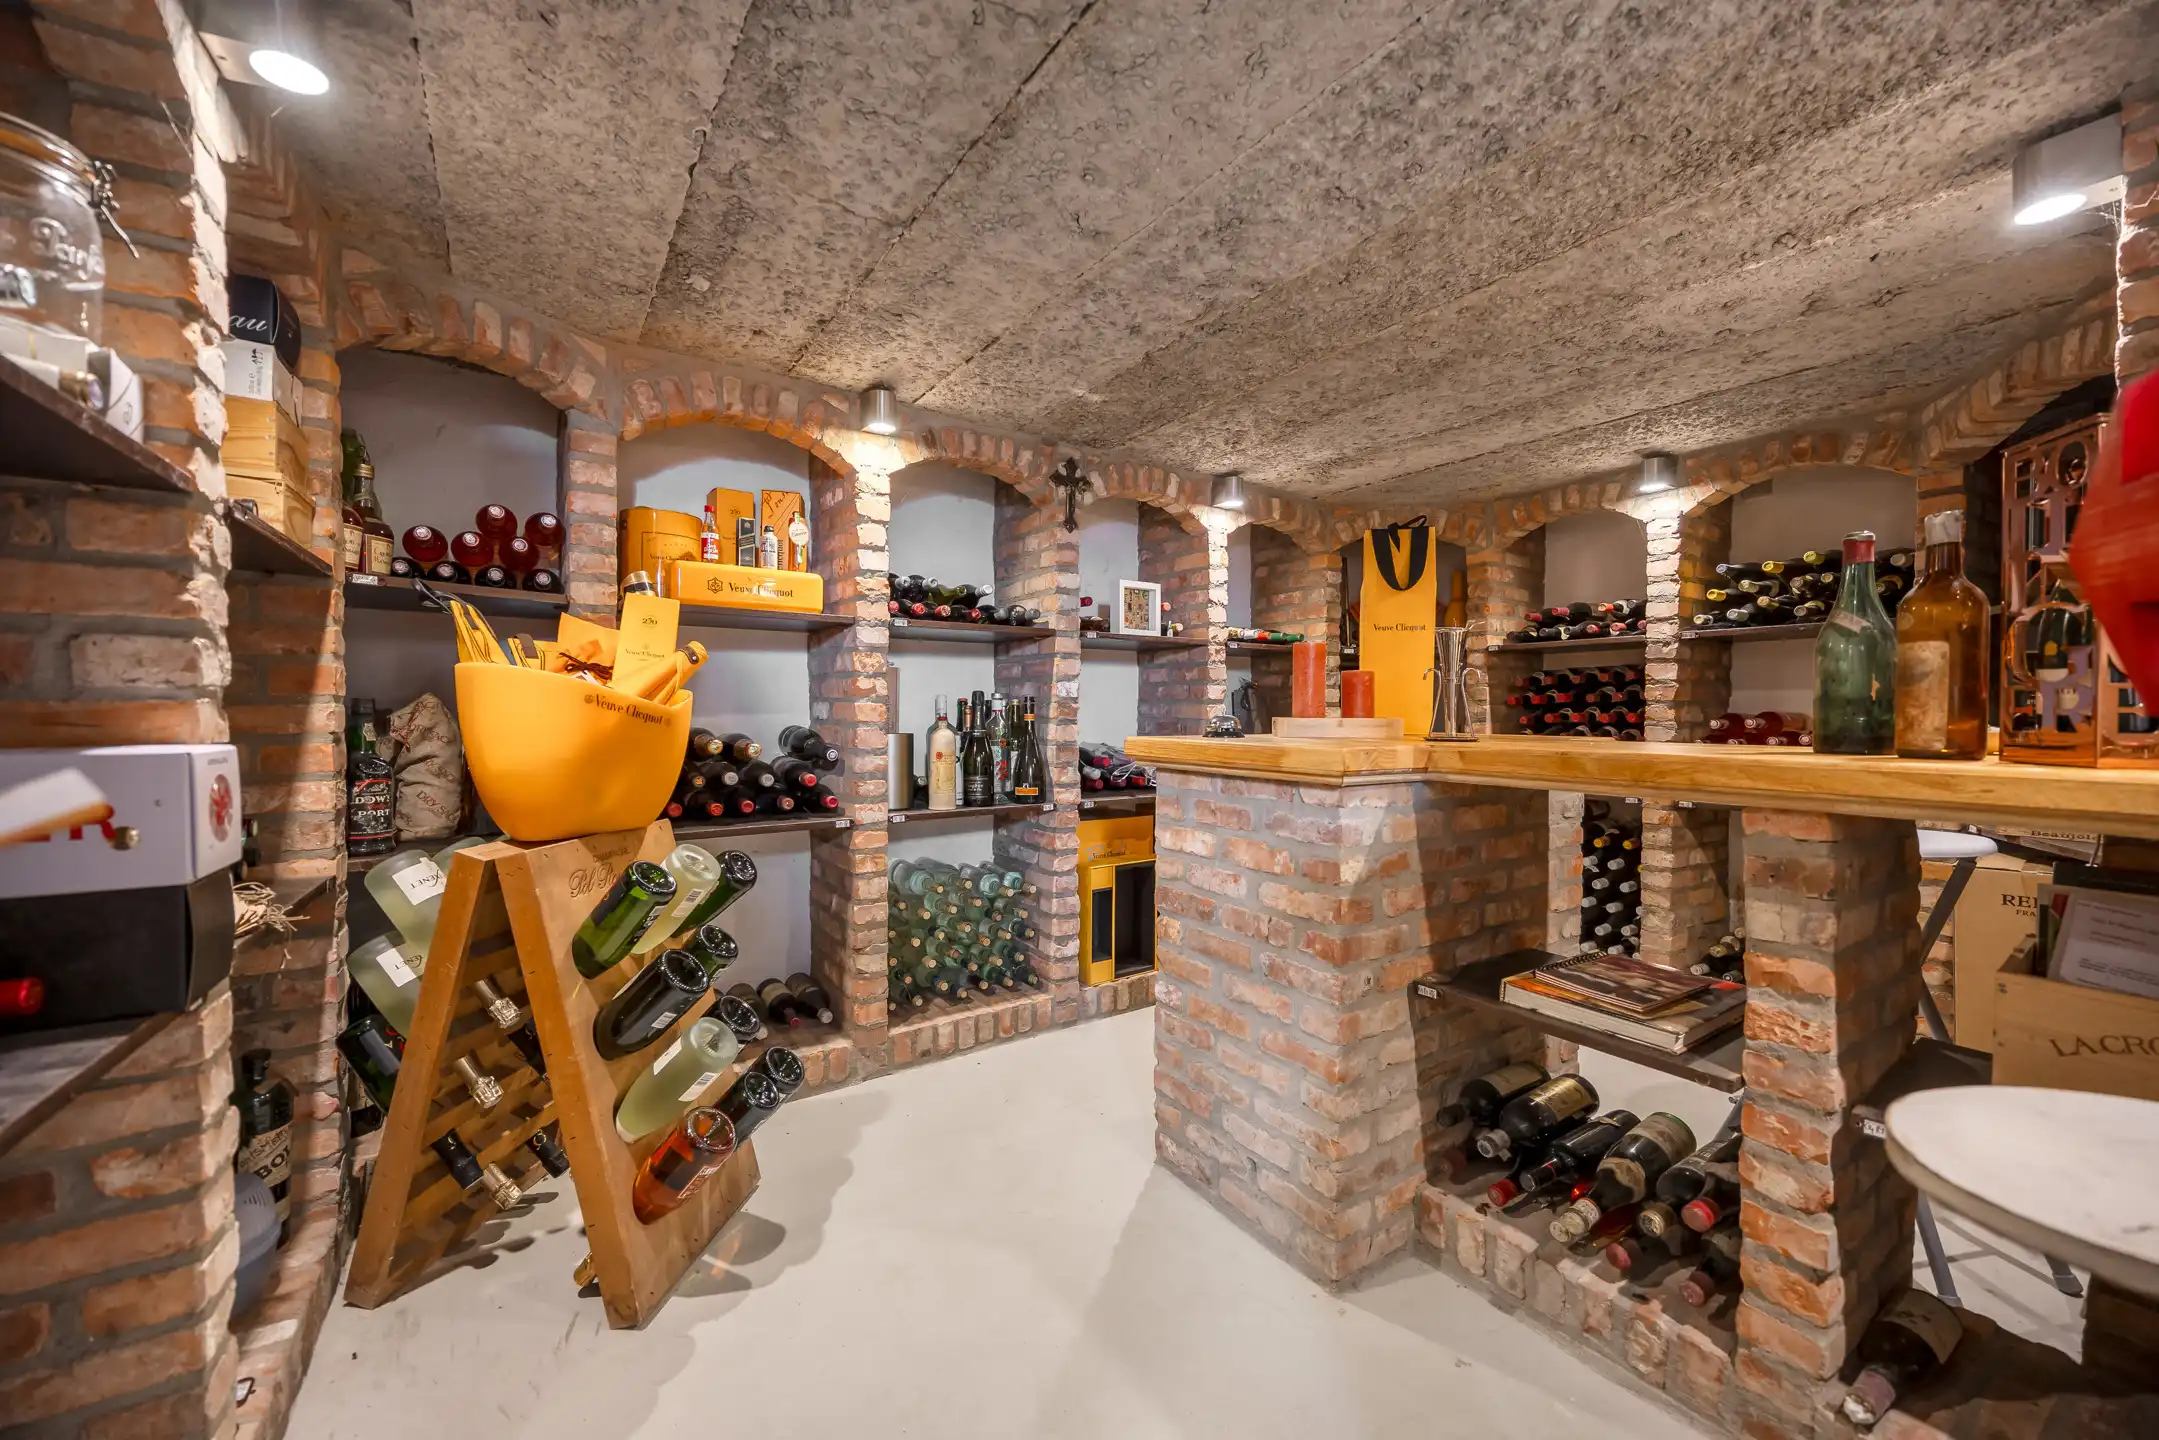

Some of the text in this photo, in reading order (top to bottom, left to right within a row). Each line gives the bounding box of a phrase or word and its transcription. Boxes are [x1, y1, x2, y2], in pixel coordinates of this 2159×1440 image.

[728, 582, 753, 593] Veuve
[1373, 623, 1426, 632] Veuve Clicquot
[595, 694, 663, 724] Veuve Clicquot
[357, 809, 391, 817] PORT
[2031, 830, 2098, 841] Beaujol
